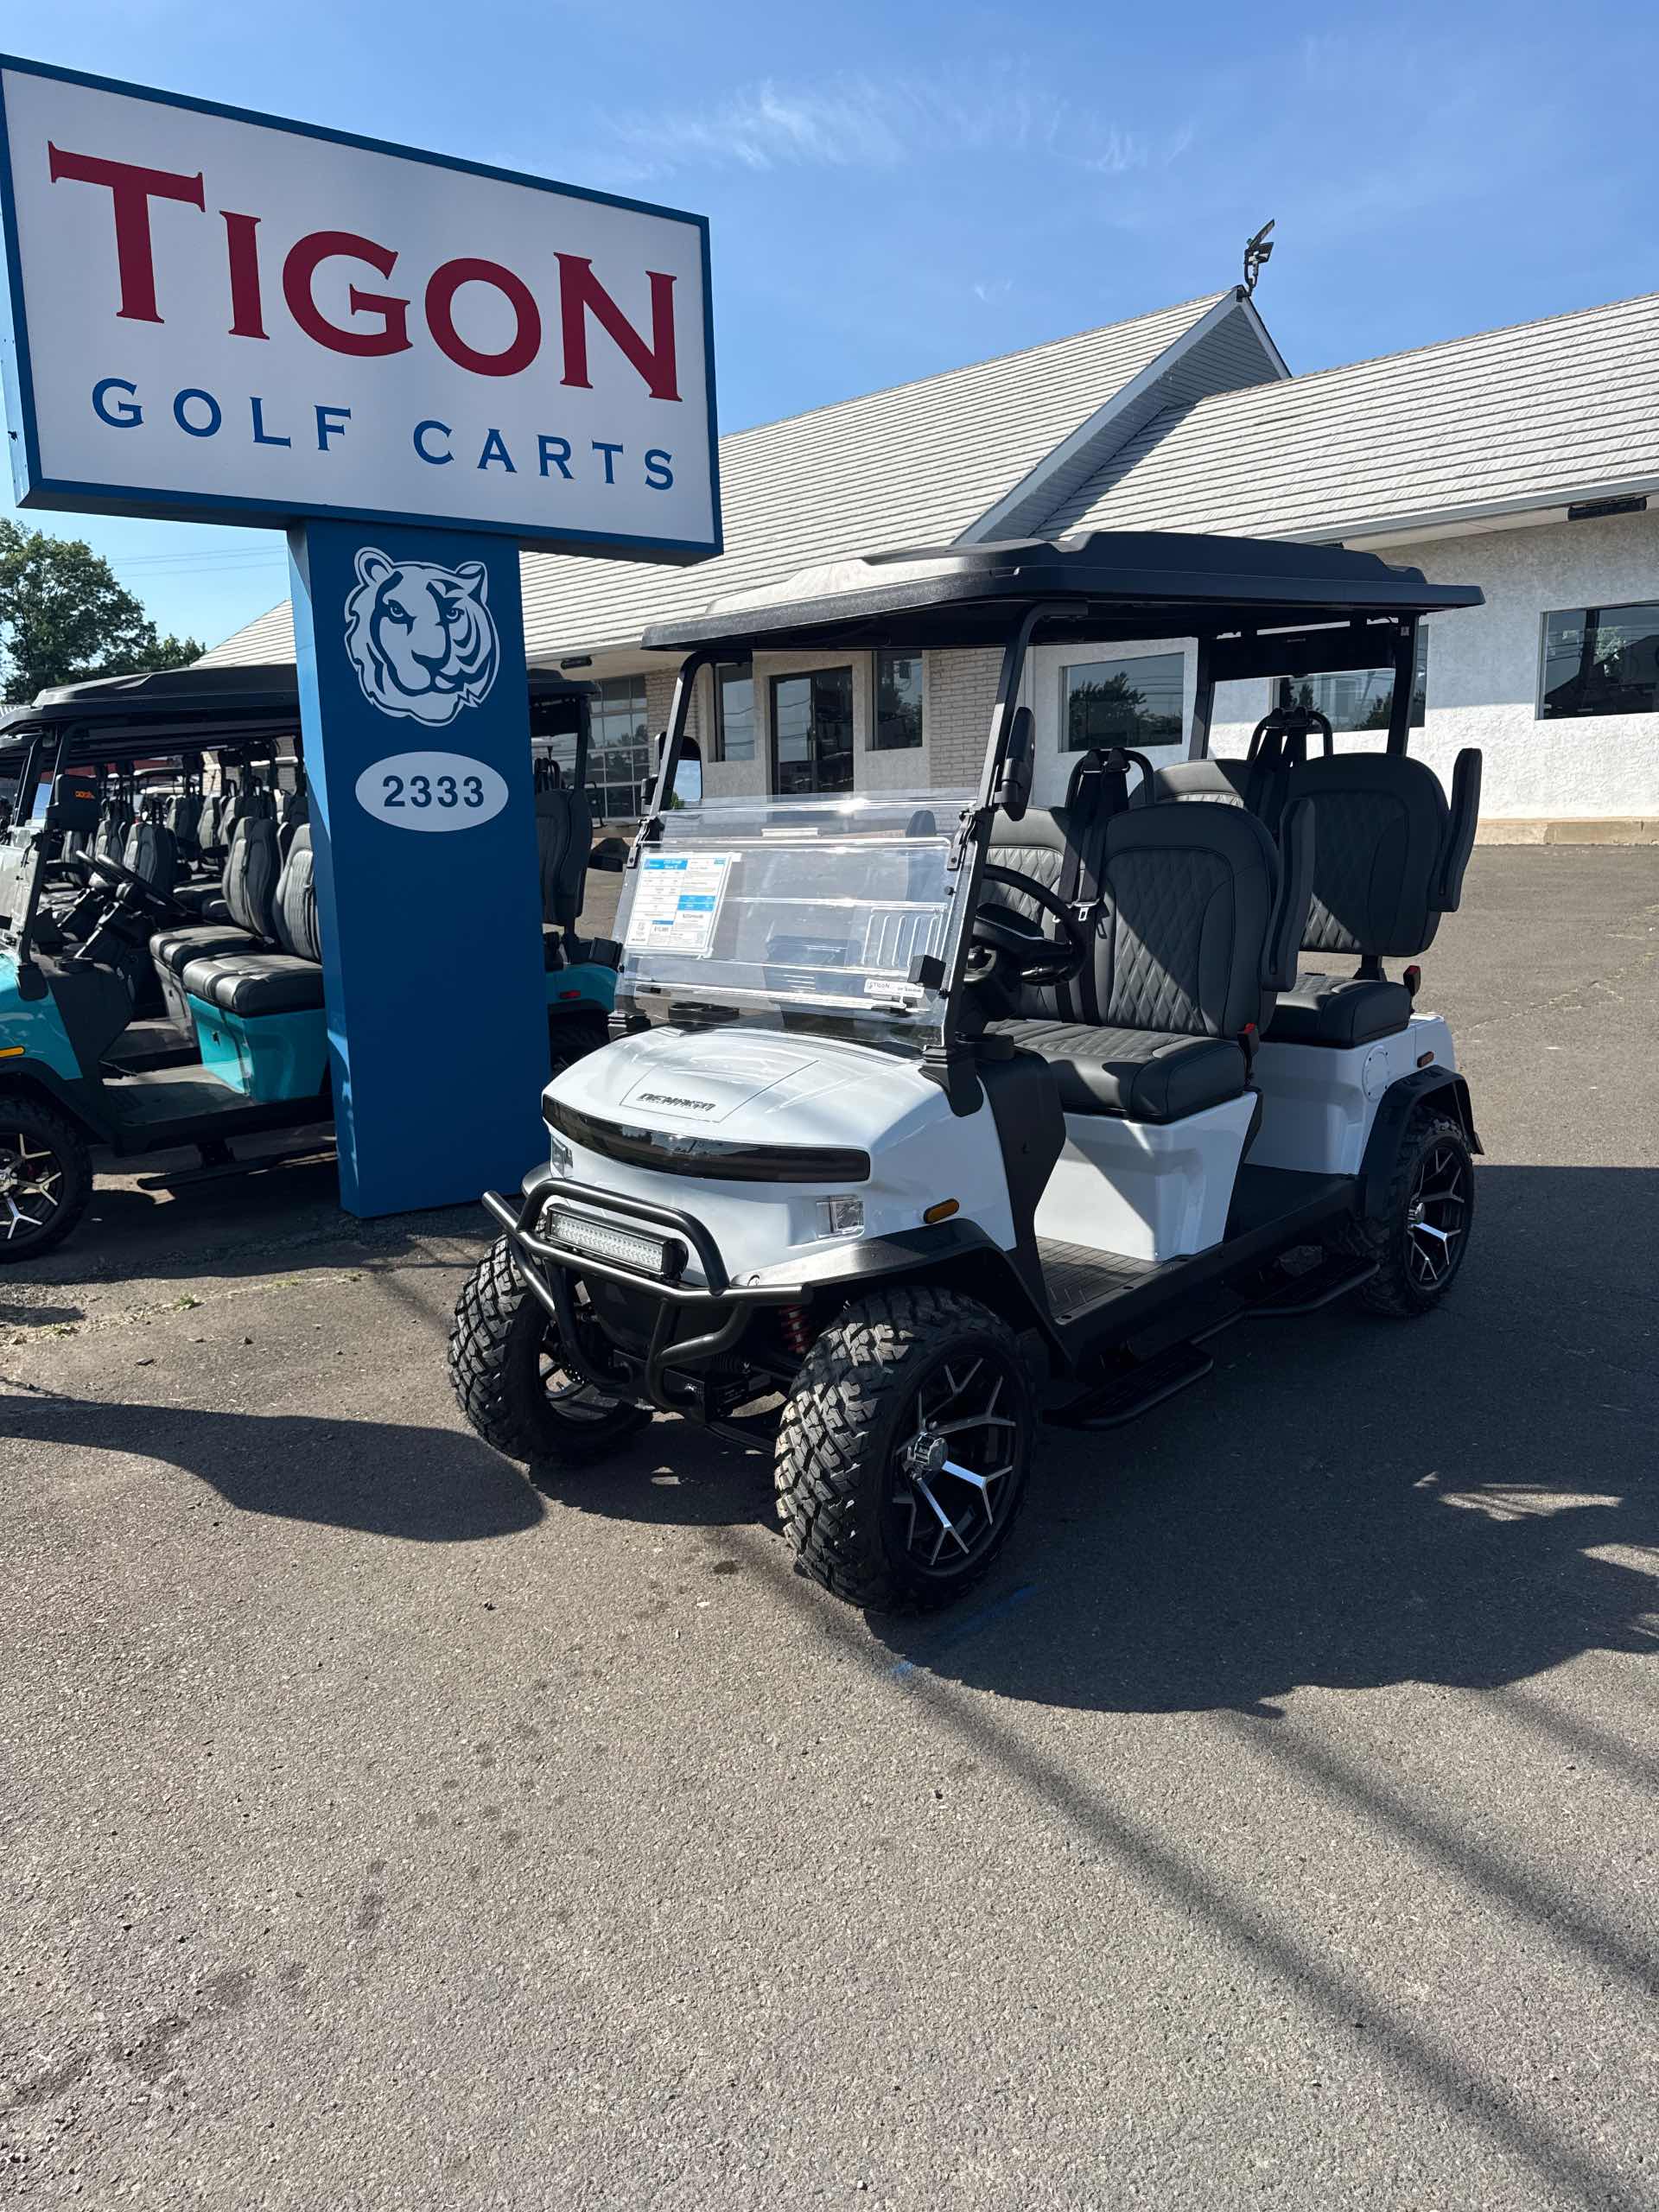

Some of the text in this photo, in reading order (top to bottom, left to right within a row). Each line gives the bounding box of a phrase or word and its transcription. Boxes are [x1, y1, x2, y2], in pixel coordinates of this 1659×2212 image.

[49, 142, 682, 402] TIGON
[92, 378, 675, 491] GOLF CARTS
[382, 775, 485, 808] 2333
